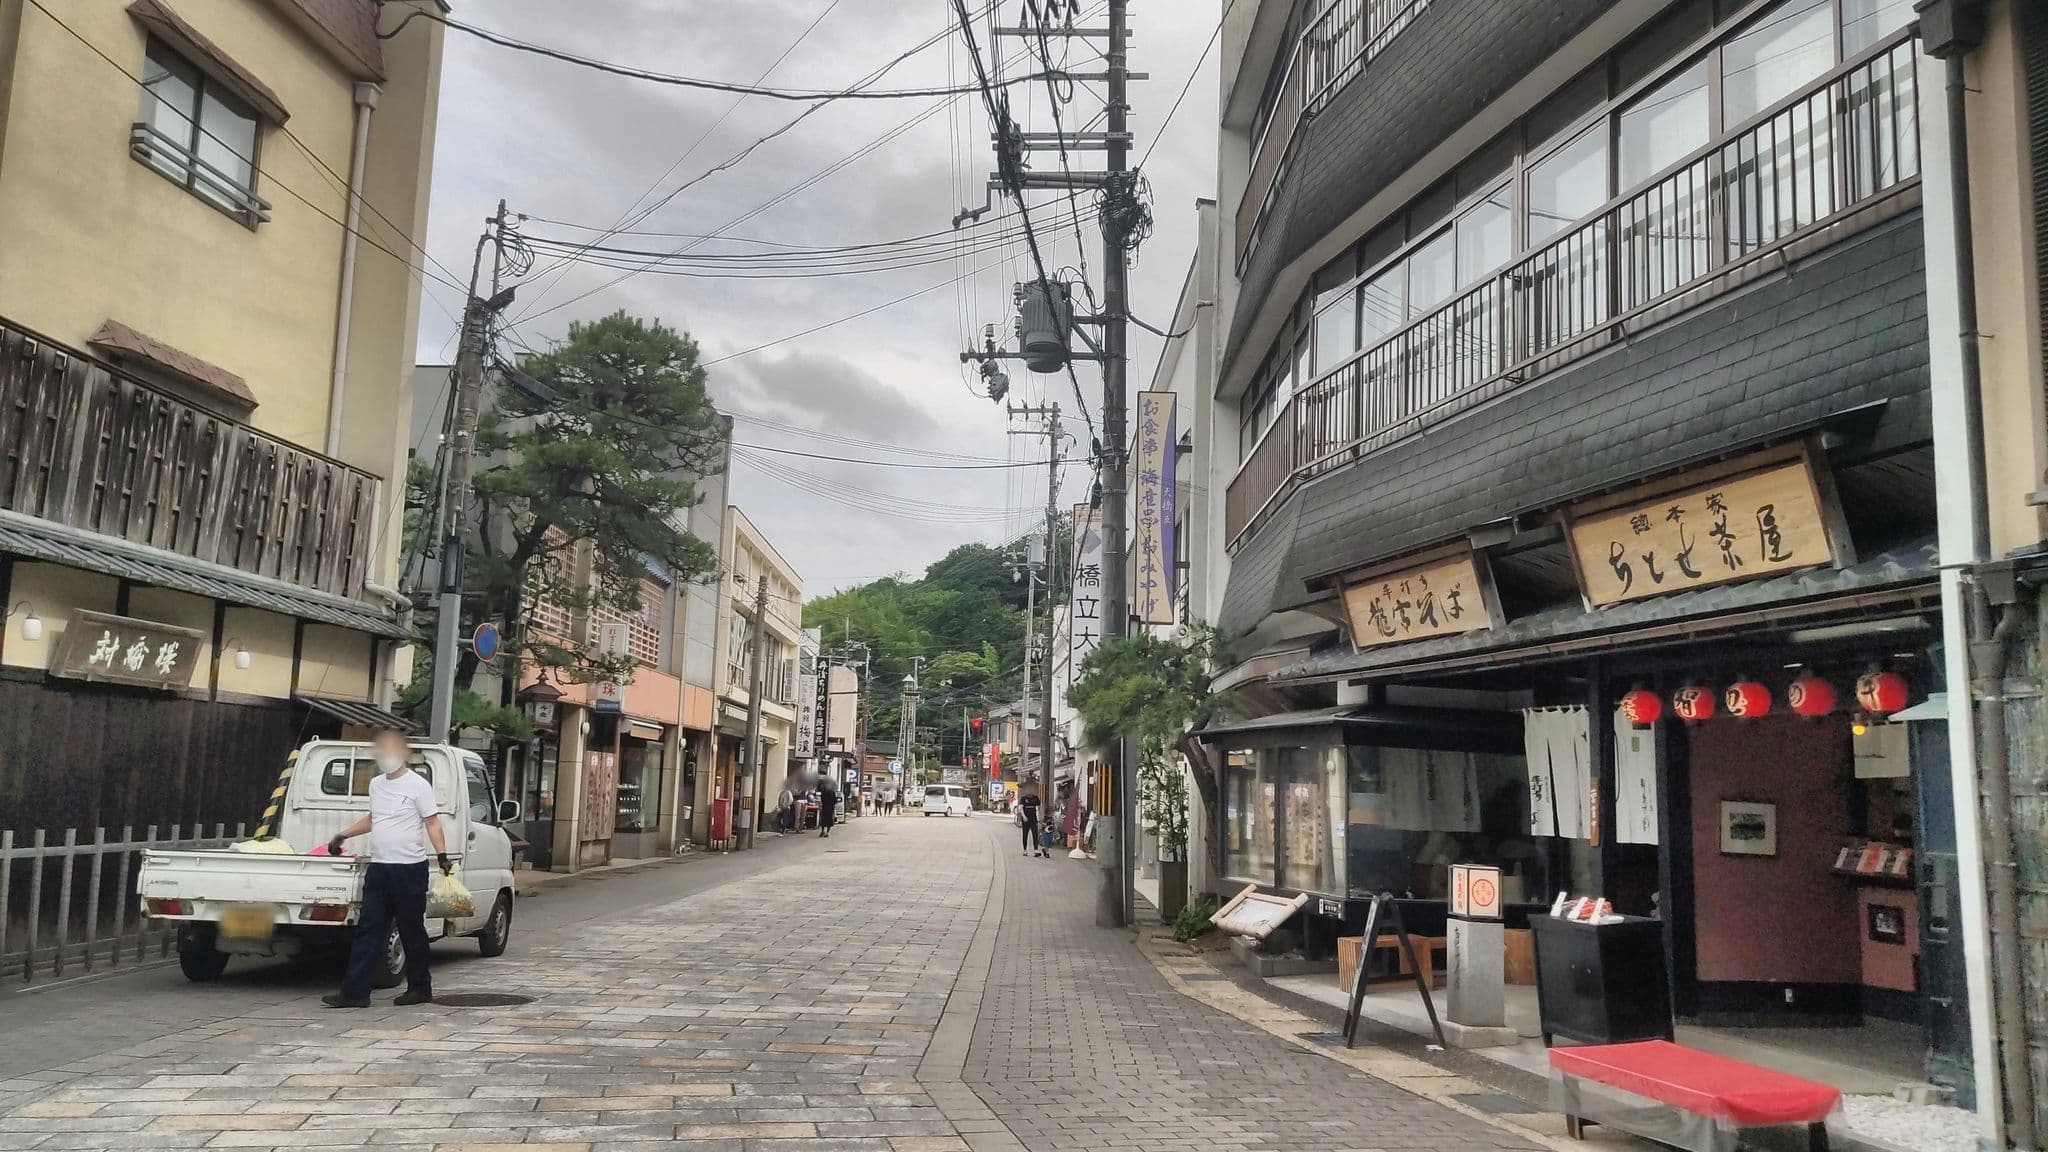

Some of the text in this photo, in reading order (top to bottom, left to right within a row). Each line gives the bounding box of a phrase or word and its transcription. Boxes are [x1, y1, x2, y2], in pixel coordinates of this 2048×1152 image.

[1609, 504, 1793, 596] ちとせ茶屋
